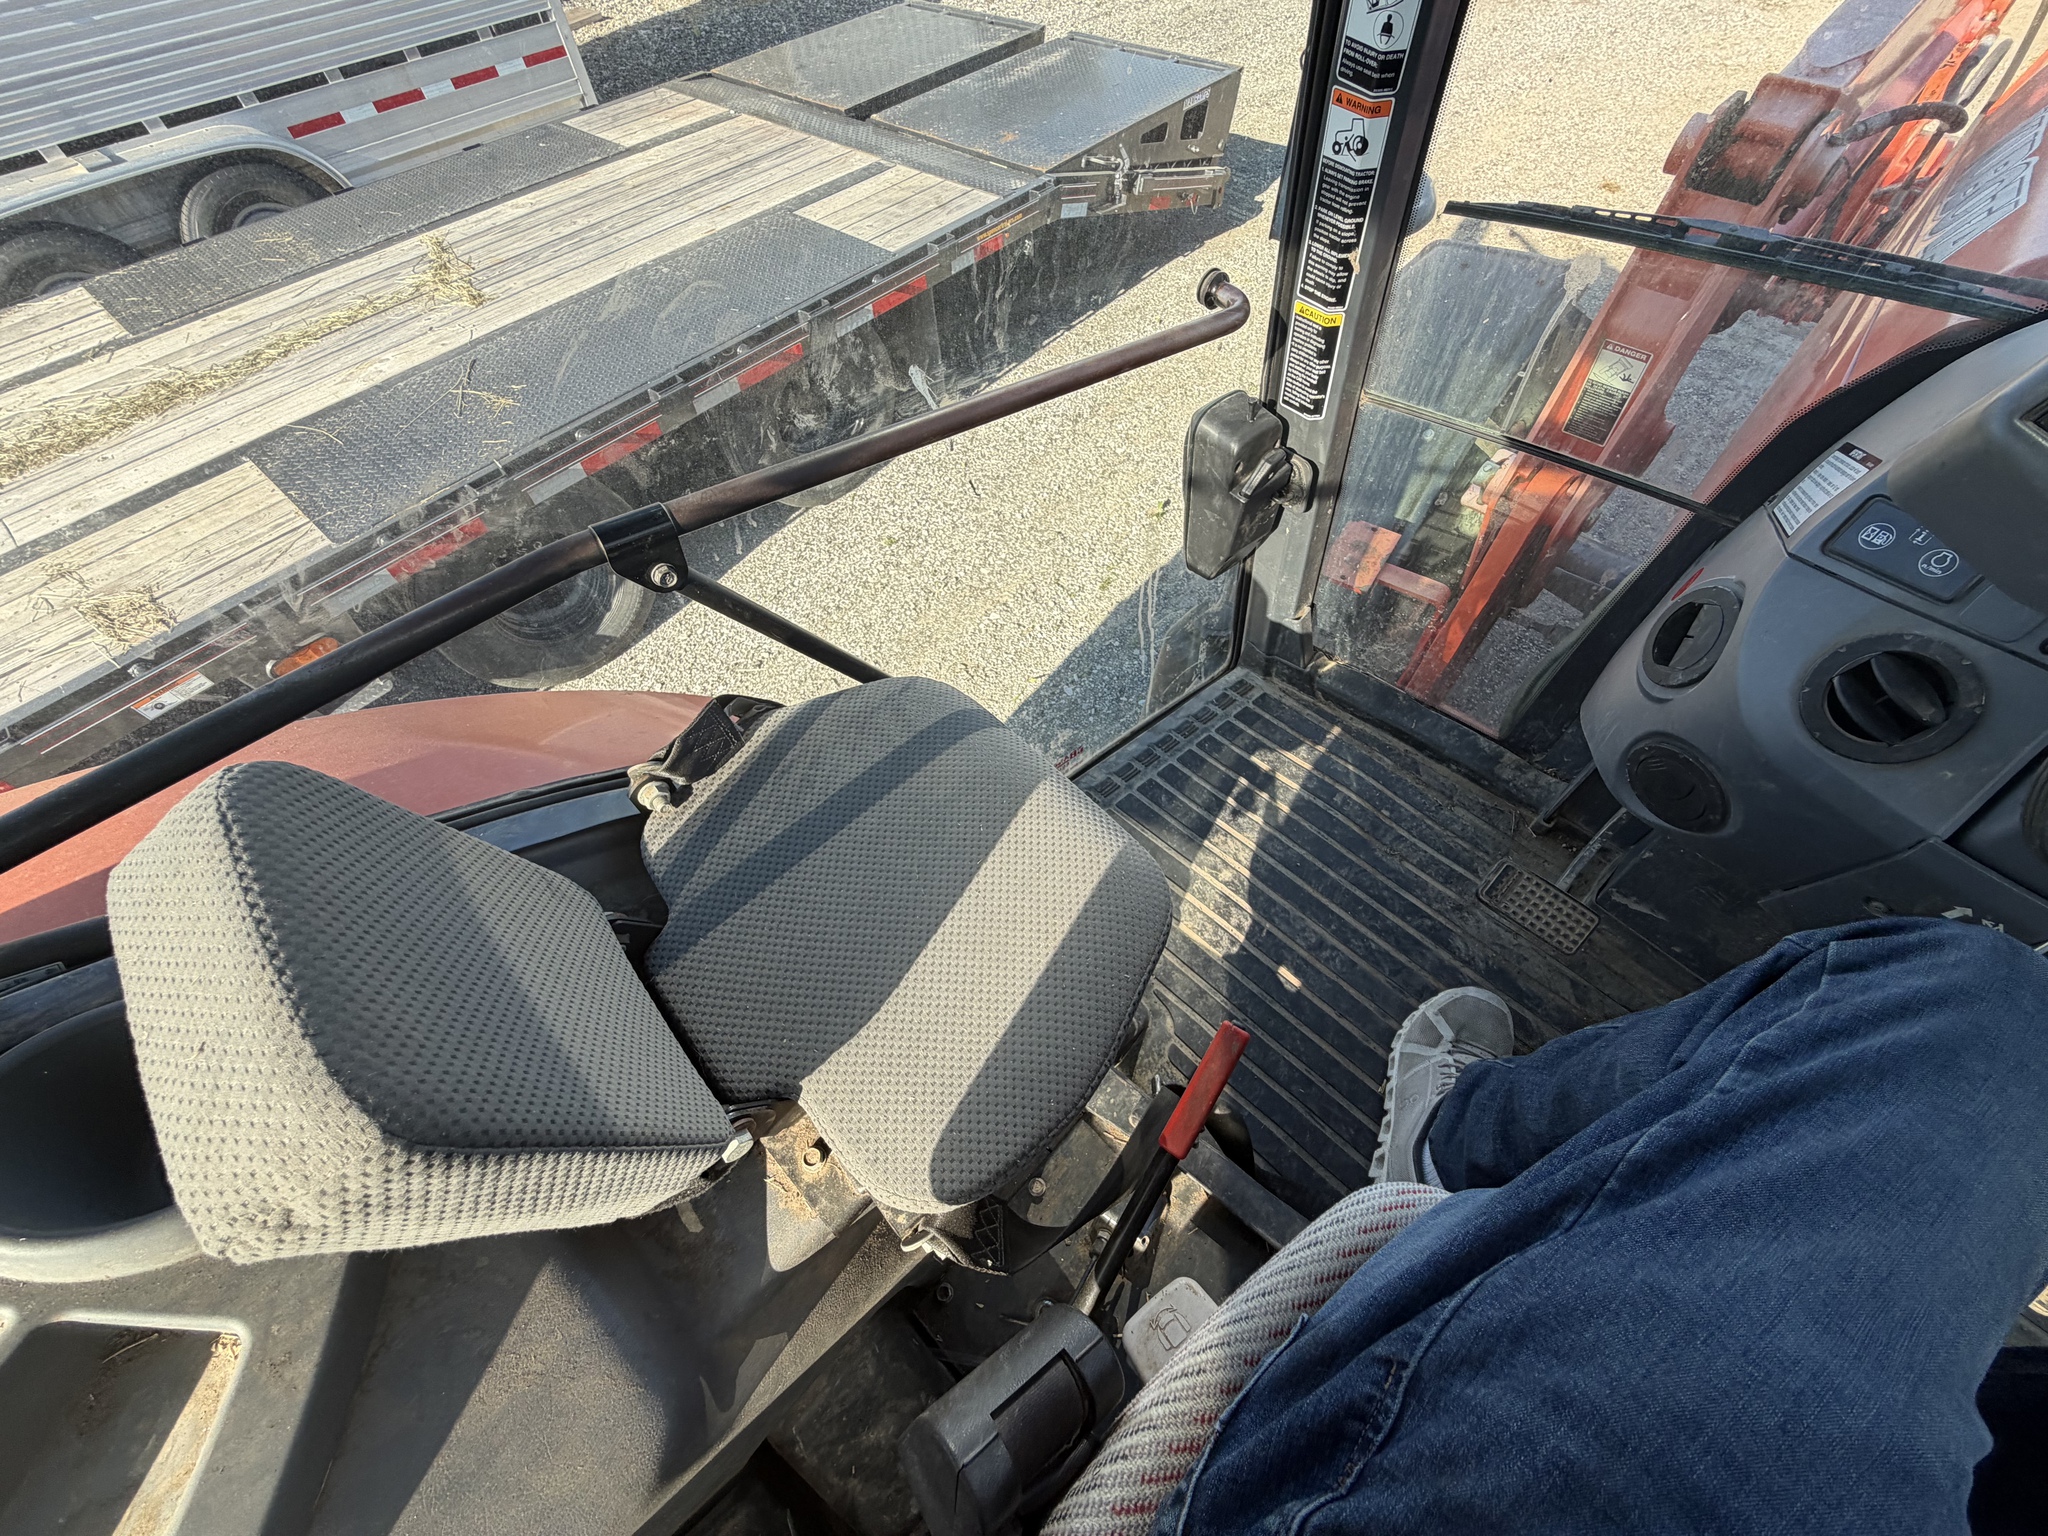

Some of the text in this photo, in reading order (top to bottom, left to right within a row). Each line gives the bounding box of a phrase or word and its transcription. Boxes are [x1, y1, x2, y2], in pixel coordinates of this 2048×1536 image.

[1343, 48, 1378, 68] FROM ROLL-OVER:
[1351, 42, 1363, 51] AVOID
[1364, 47, 1378, 58] INJURY
[1342, 58, 1355, 68] Always
[1346, 97, 1381, 114] WARNING
[1323, 175, 1338, 186] Leaving
[1303, 307, 1337, 325] CAUTION
[1614, 346, 1647, 361] DANGER
